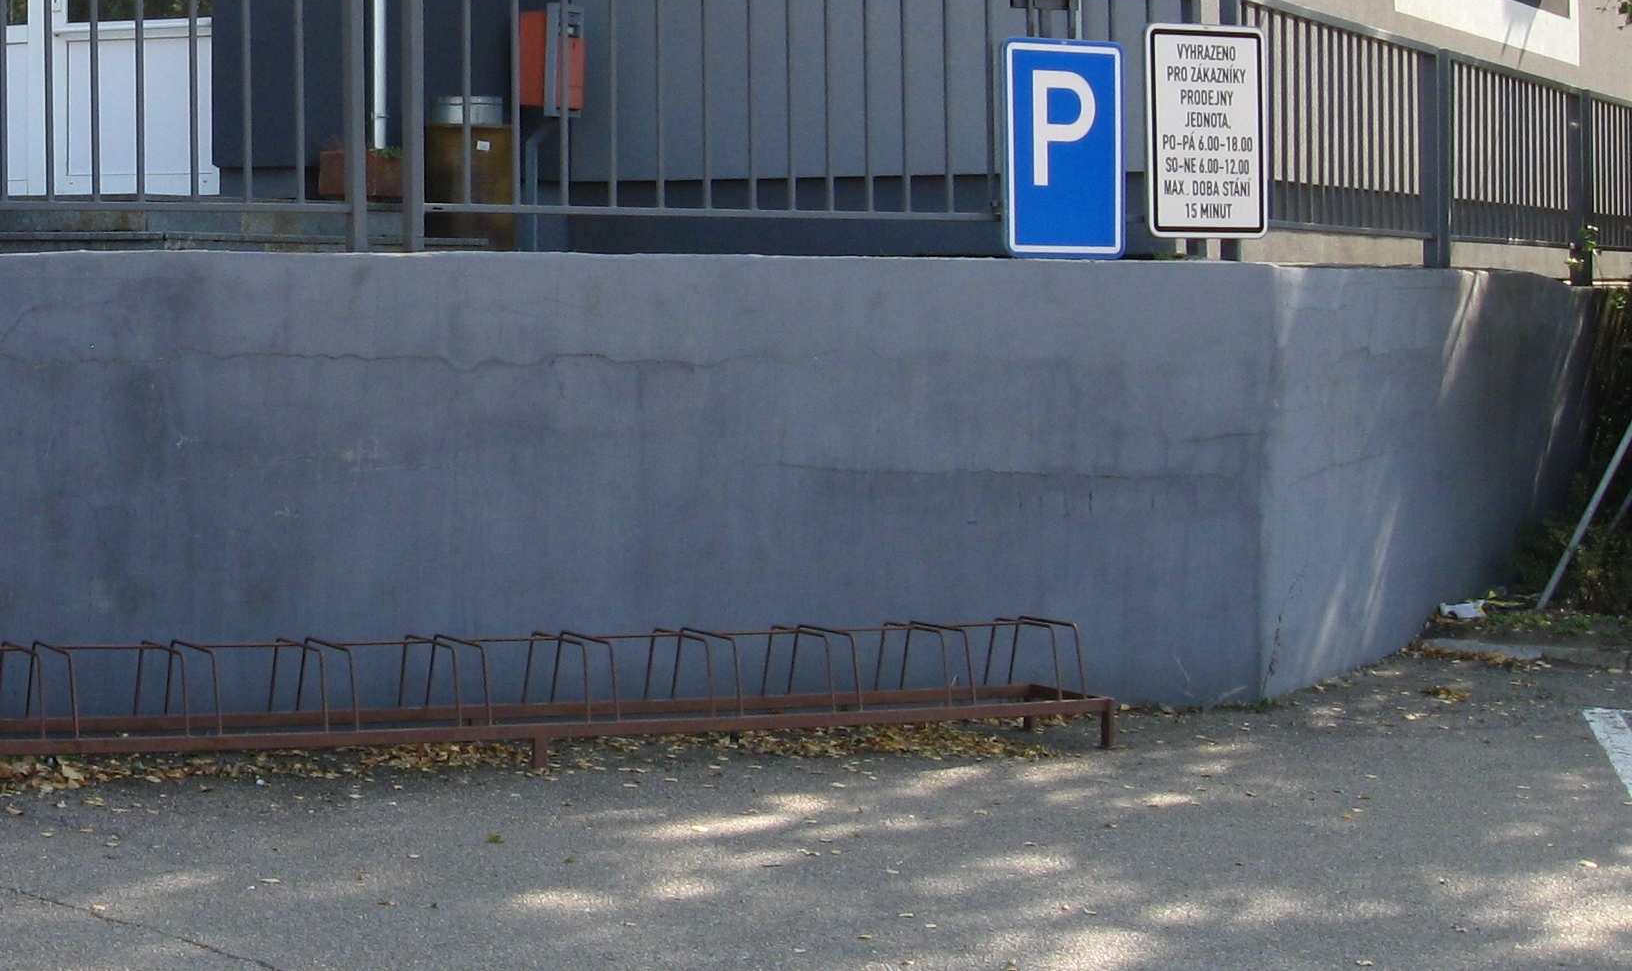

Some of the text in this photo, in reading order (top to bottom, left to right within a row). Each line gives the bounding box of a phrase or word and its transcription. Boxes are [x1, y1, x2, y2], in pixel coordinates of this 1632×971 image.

[1176, 43, 1236, 61] VYHRAZENO
[1166, 63, 1246, 84] PRO ZÁKAZNÍKY
[1180, 89, 1234, 106] PRODEJNY
[1032, 69, 1096, 186] P
[1162, 131, 1253, 152] PO-PÁ 6.00-18.00
[1165, 157, 1250, 174] SO-NE 6.00-12.00
[1163, 177, 1252, 197] MAX. DOBA STÁNÍ
[1185, 202, 1232, 219] 15 MINUT
